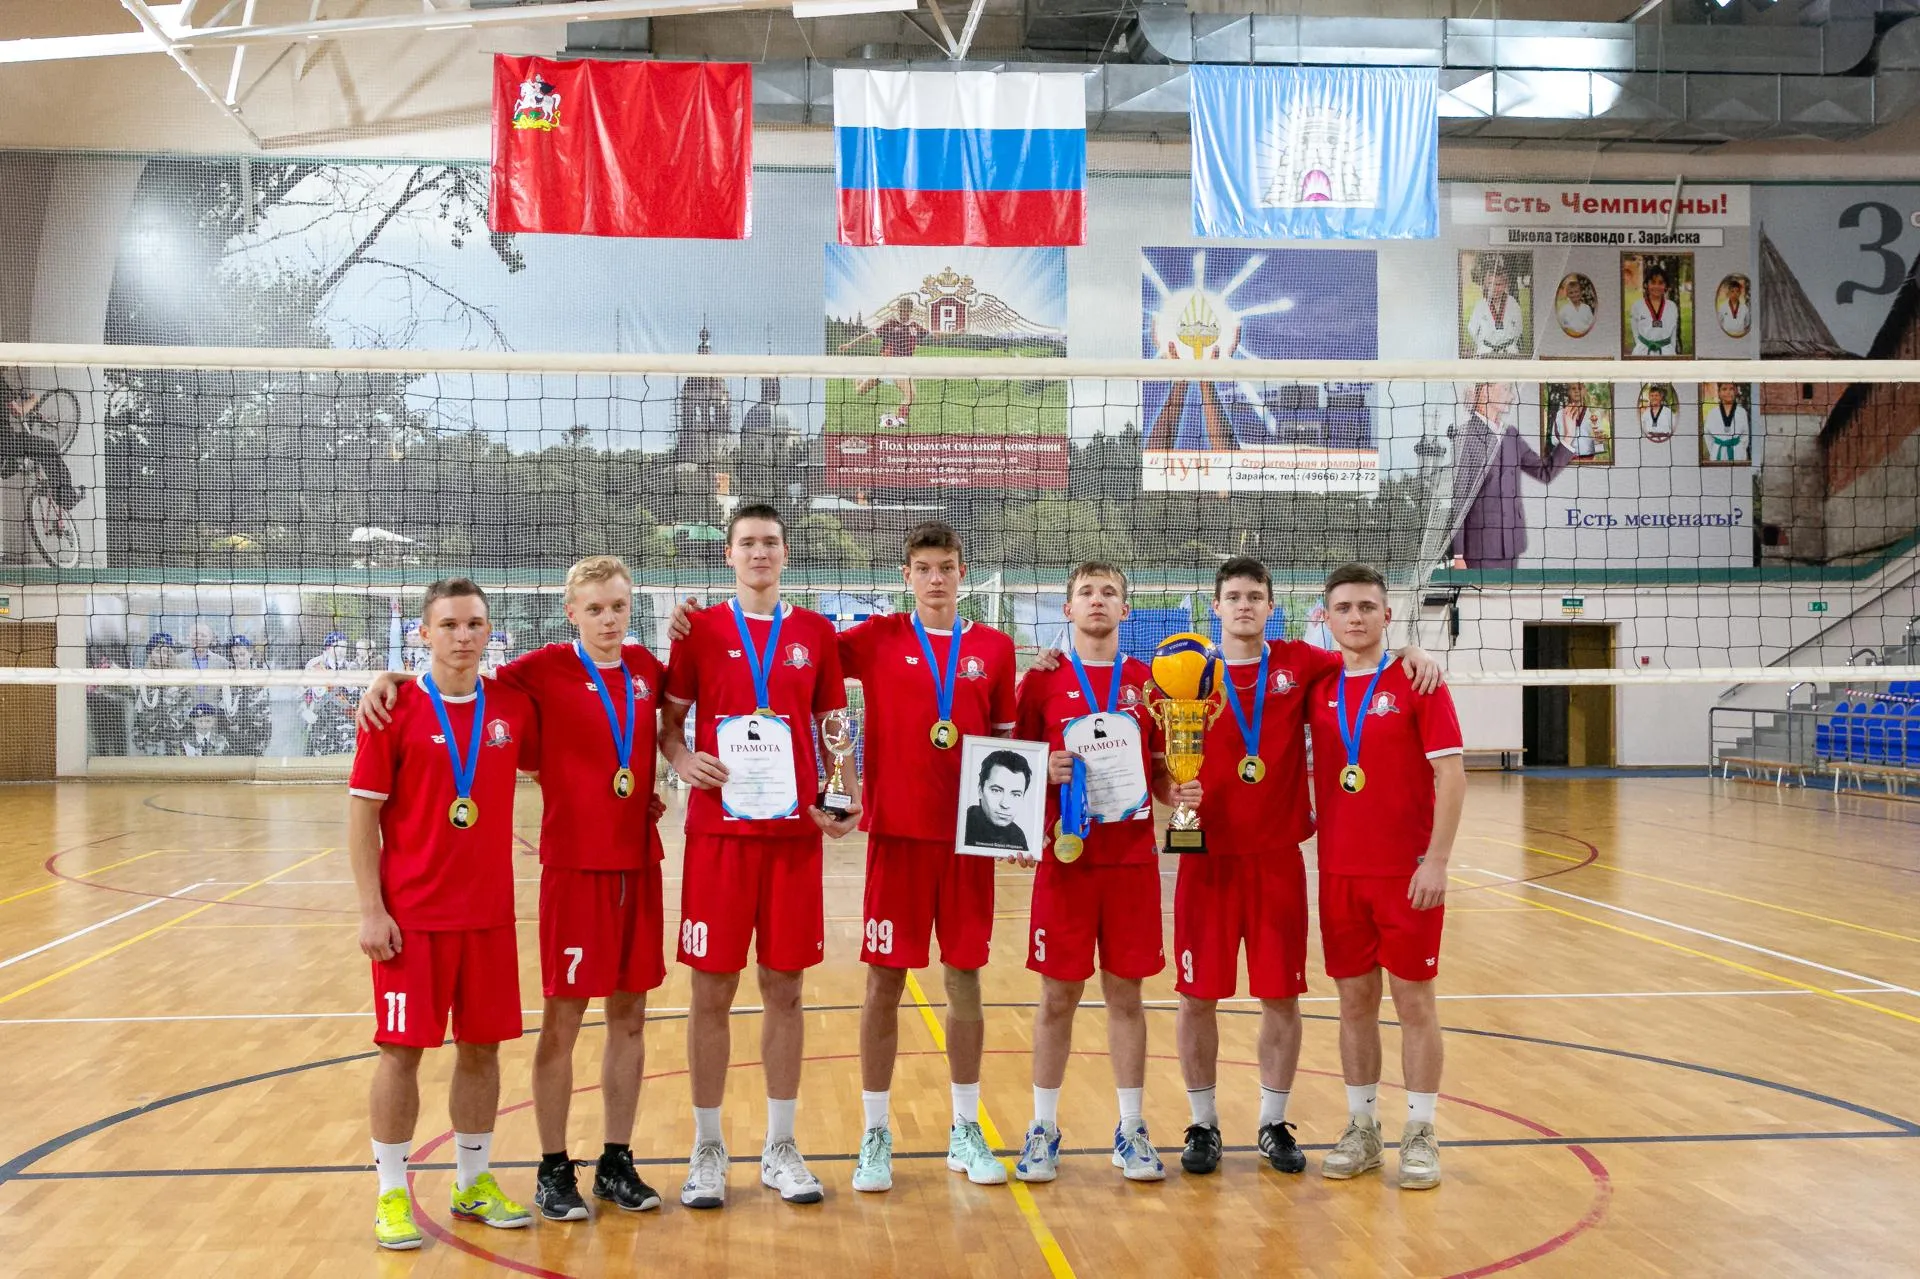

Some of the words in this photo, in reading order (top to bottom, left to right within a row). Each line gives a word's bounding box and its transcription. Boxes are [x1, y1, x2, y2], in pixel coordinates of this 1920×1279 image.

[1484, 191, 1551, 214] Есть
[1561, 192, 1728, 215] Чемпионы!
[1508, 228, 1552, 244] Школа
[1627, 233, 1637, 244] г.
[879, 440, 904, 452] Под
[906, 442, 951, 454] крылом
[954, 441, 1001, 452] сильной
[1004, 443, 1062, 452] компании
[1241, 458, 1317, 468] Строительная
[1320, 459, 1377, 469] компания
[1235, 472, 1278, 482] Зарайск,
[1280, 473, 1300, 481] тел.:
[1301, 472, 1339, 482] (49666)
[1340, 472, 1377, 481] 2-72-72
[1565, 508, 1618, 527] Есть
[1625, 507, 1743, 529] меценаты?
[730, 744, 781, 753] ГРАМОТА
[1078, 739, 1128, 754] ГРАМОТА
[682, 918, 708, 958] 80
[865, 918, 893, 955] 99
[1034, 928, 1046, 962] 5
[563, 947, 583, 985] 7
[1181, 949, 1194, 983] 9
[383, 991, 407, 1033] 11
